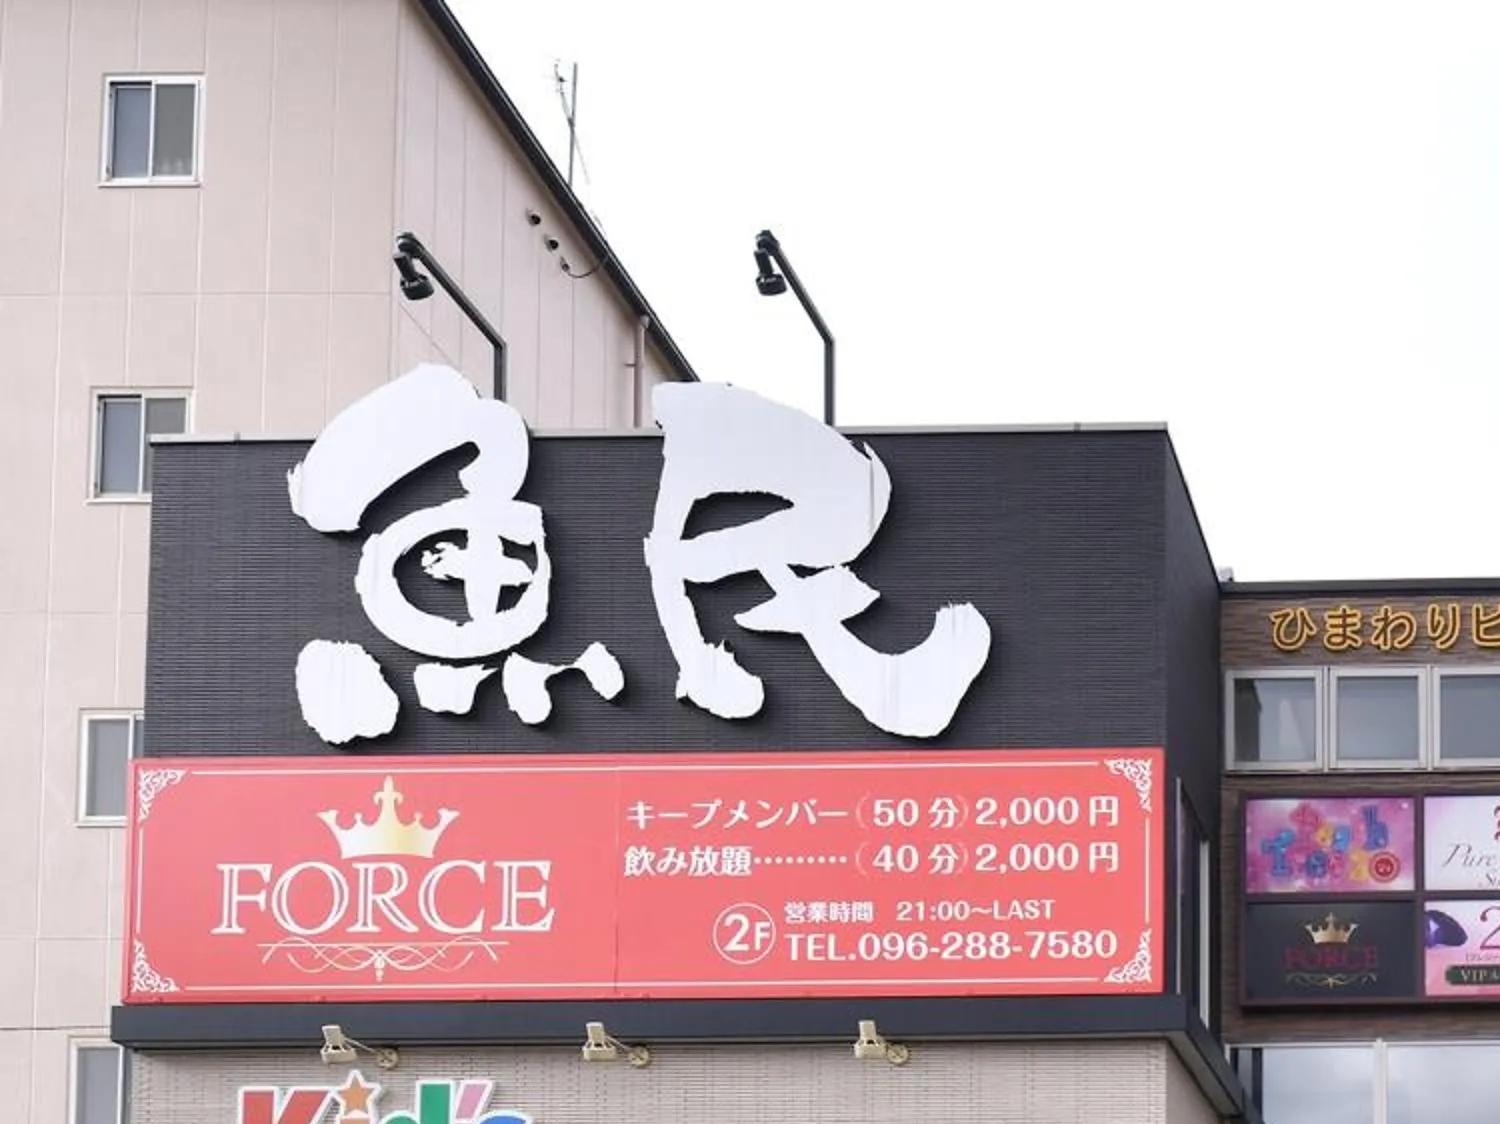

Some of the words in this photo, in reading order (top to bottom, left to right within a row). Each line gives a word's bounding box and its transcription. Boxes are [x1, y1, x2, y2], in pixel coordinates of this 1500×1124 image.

[287, 362, 991, 745] 魚民
[1440, 843, 1498, 869] Pure
[211, 861, 555, 935] FORCE
[784, 900, 875, 924] 営業時間
[722, 913, 771, 953] 2F
[785, 930, 1118, 960] TEL.096-288-7580
